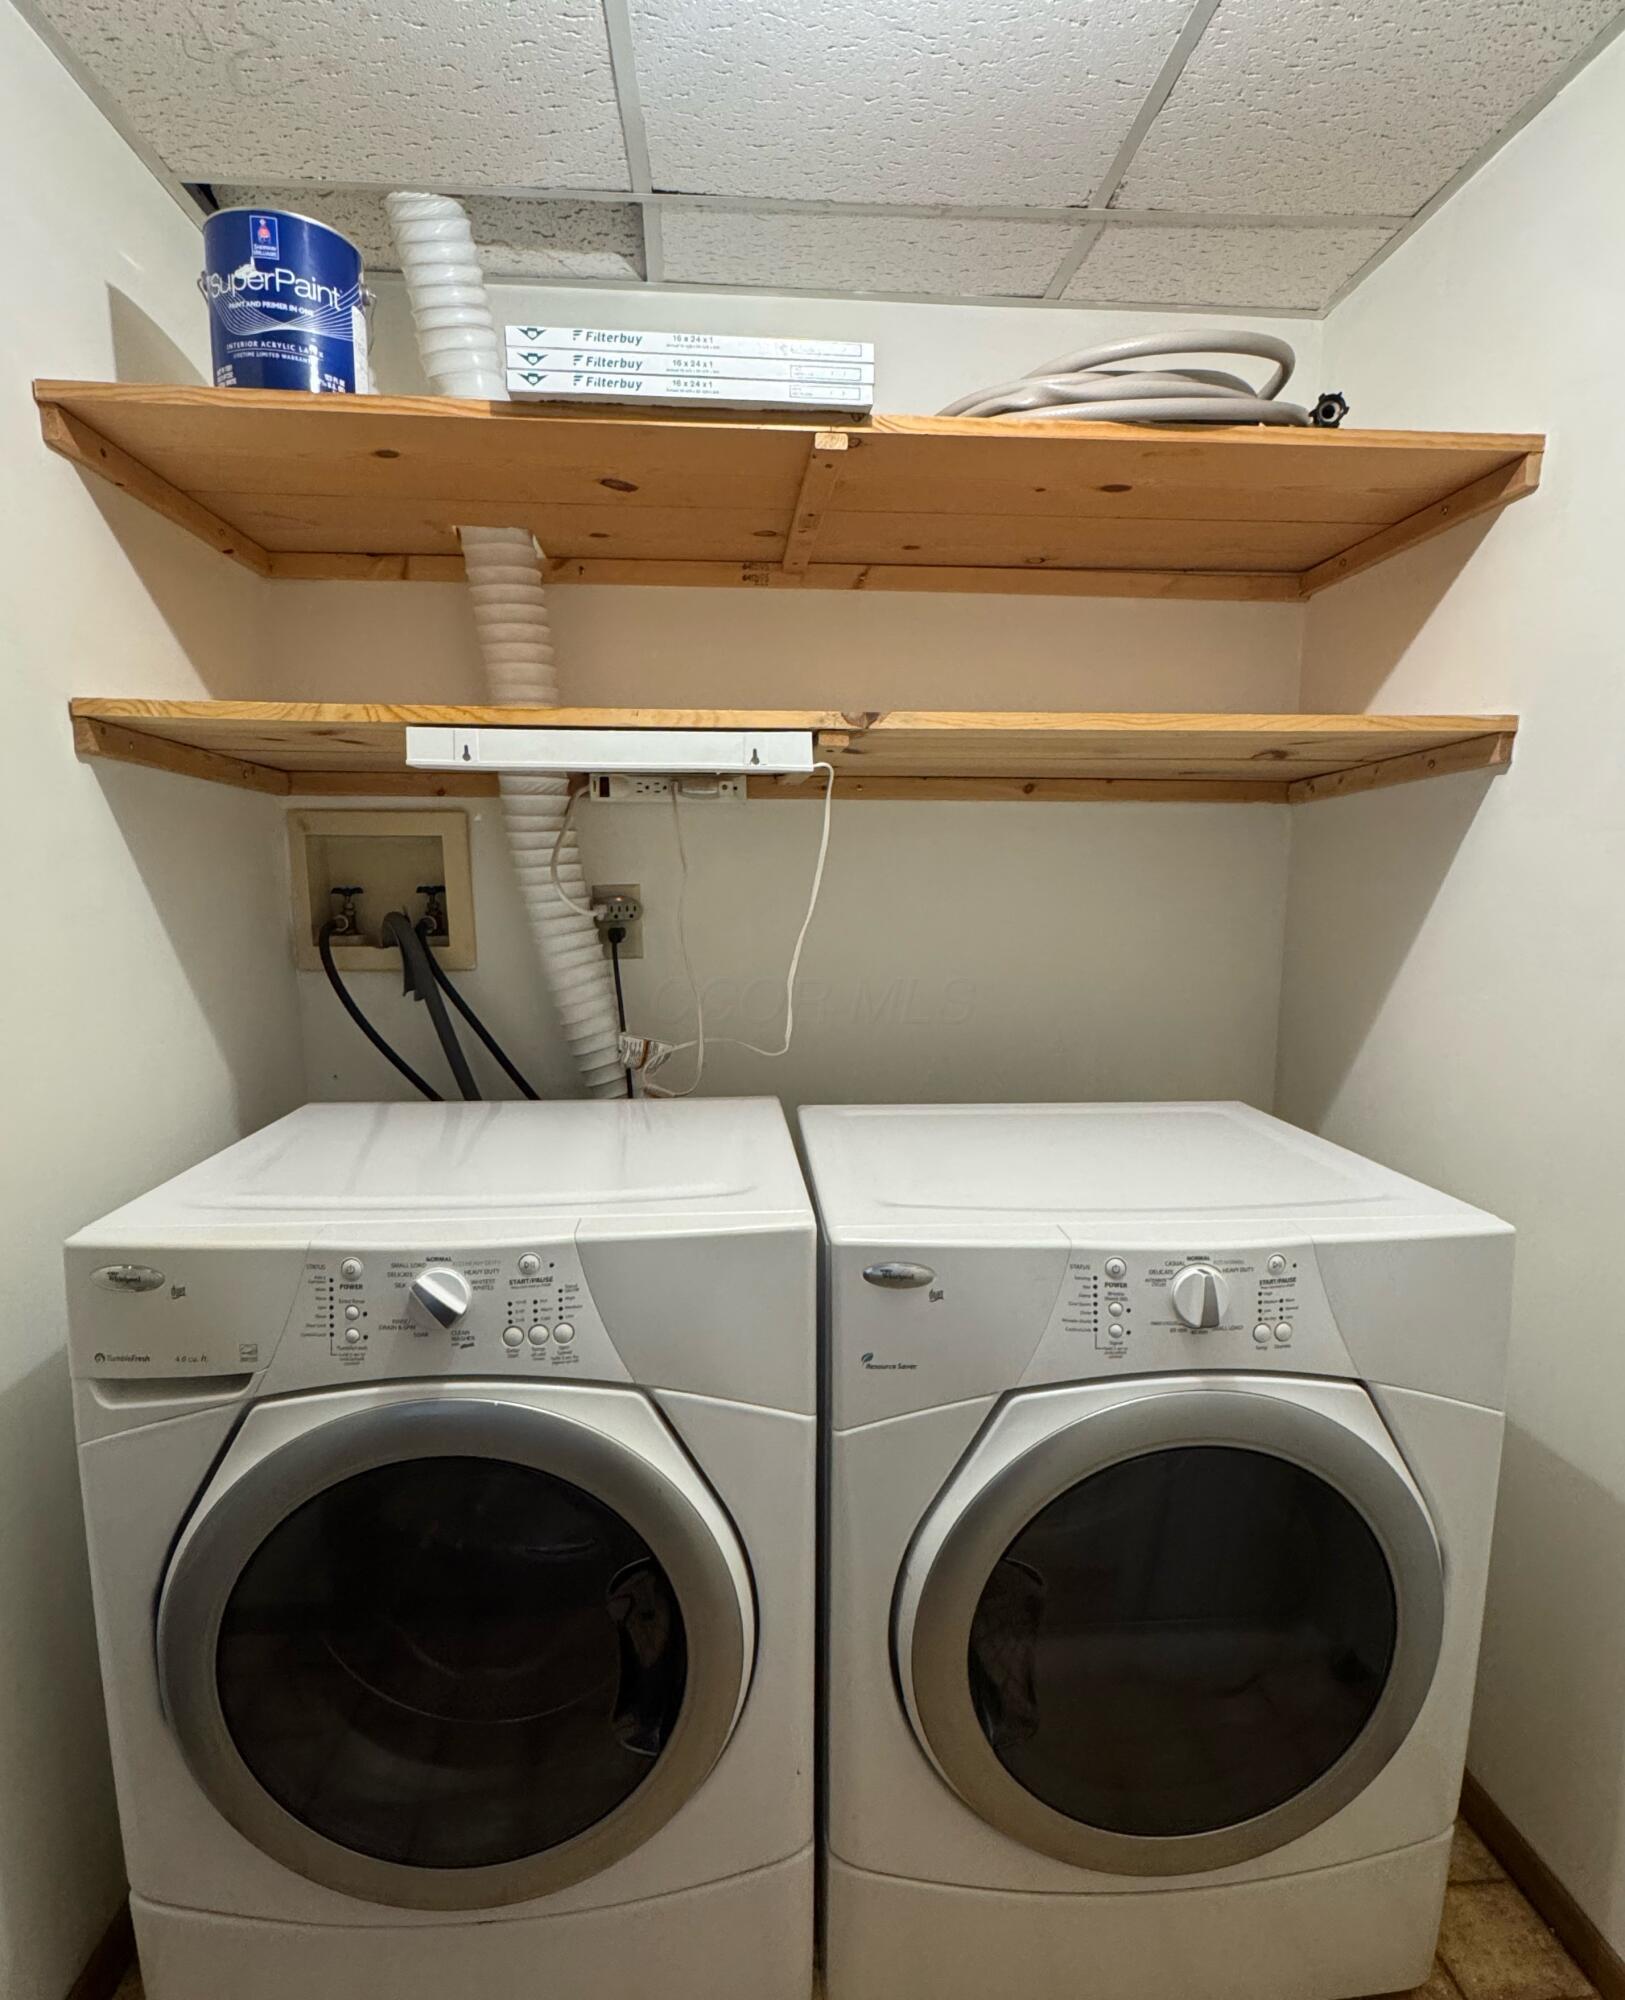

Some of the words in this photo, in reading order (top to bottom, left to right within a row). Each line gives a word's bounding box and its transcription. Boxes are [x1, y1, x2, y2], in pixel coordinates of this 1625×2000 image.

[210, 267, 341, 312] SuperPaint
[246, 300, 261, 308] AND
[262, 301, 288, 311] PRIMER
[289, 305, 298, 313] IN
[298, 306, 315, 316] ONE
[585, 331, 643, 346] Filterbuy
[673, 335, 682, 343] 16
[226, 340, 258, 350] INTERIOR
[261, 341, 296, 352] ACRYLIC
[299, 345, 324, 358] LAX
[256, 351, 281, 359] LIMITED
[585, 356, 643, 371] Filterbuy
[673, 359, 682, 367] 16
[690, 360, 701, 368] 24
[585, 376, 643, 391] Filterbuy
[673, 379, 682, 387] 16
[690, 380, 701, 388] 24
[509, 1276, 553, 1286] START/PAUSE
[1259, 1276, 1297, 1286] START/PAUSE
